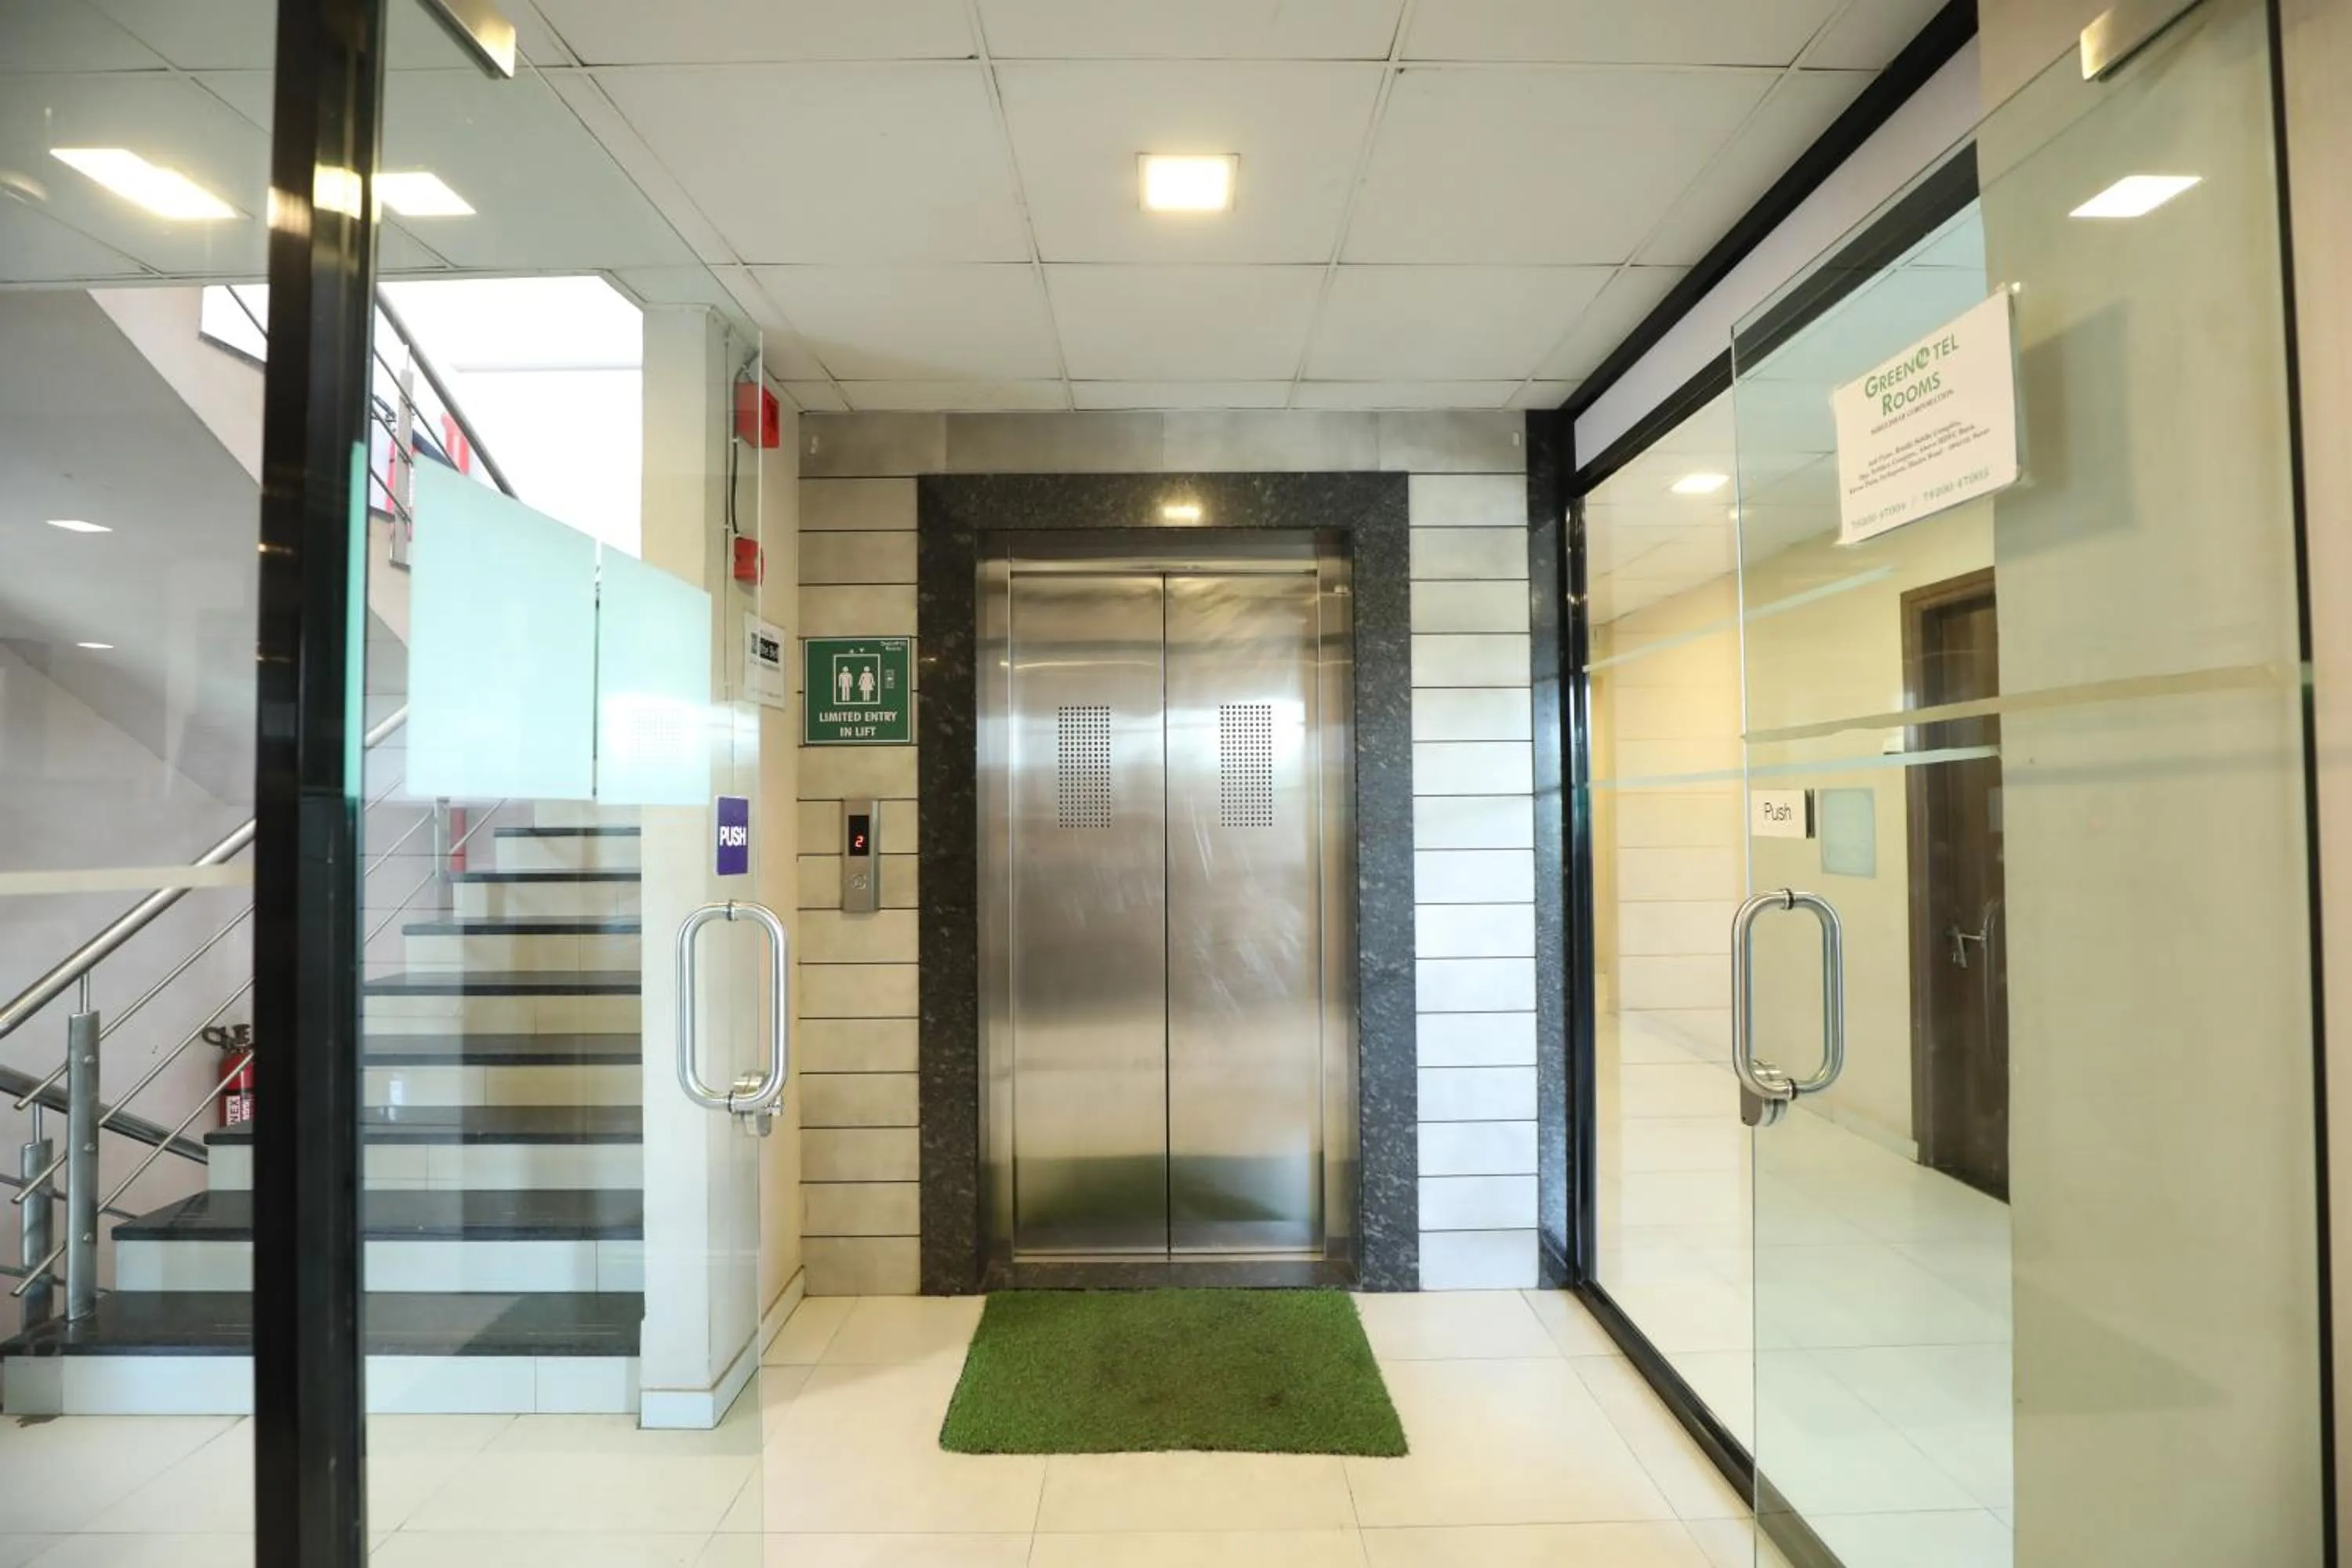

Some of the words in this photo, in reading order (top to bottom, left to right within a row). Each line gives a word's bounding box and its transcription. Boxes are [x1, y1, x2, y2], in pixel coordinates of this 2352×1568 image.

[1882, 372, 1941, 416] ROOMS
[819, 711, 862, 722] LIMITED
[865, 711, 898, 722] ENTRY
[840, 727, 852, 737] IN
[855, 727, 877, 736] LIFT
[1764, 802, 1792, 821] Push
[719, 826, 747, 847] PUSH
[855, 834, 864, 848] 2
